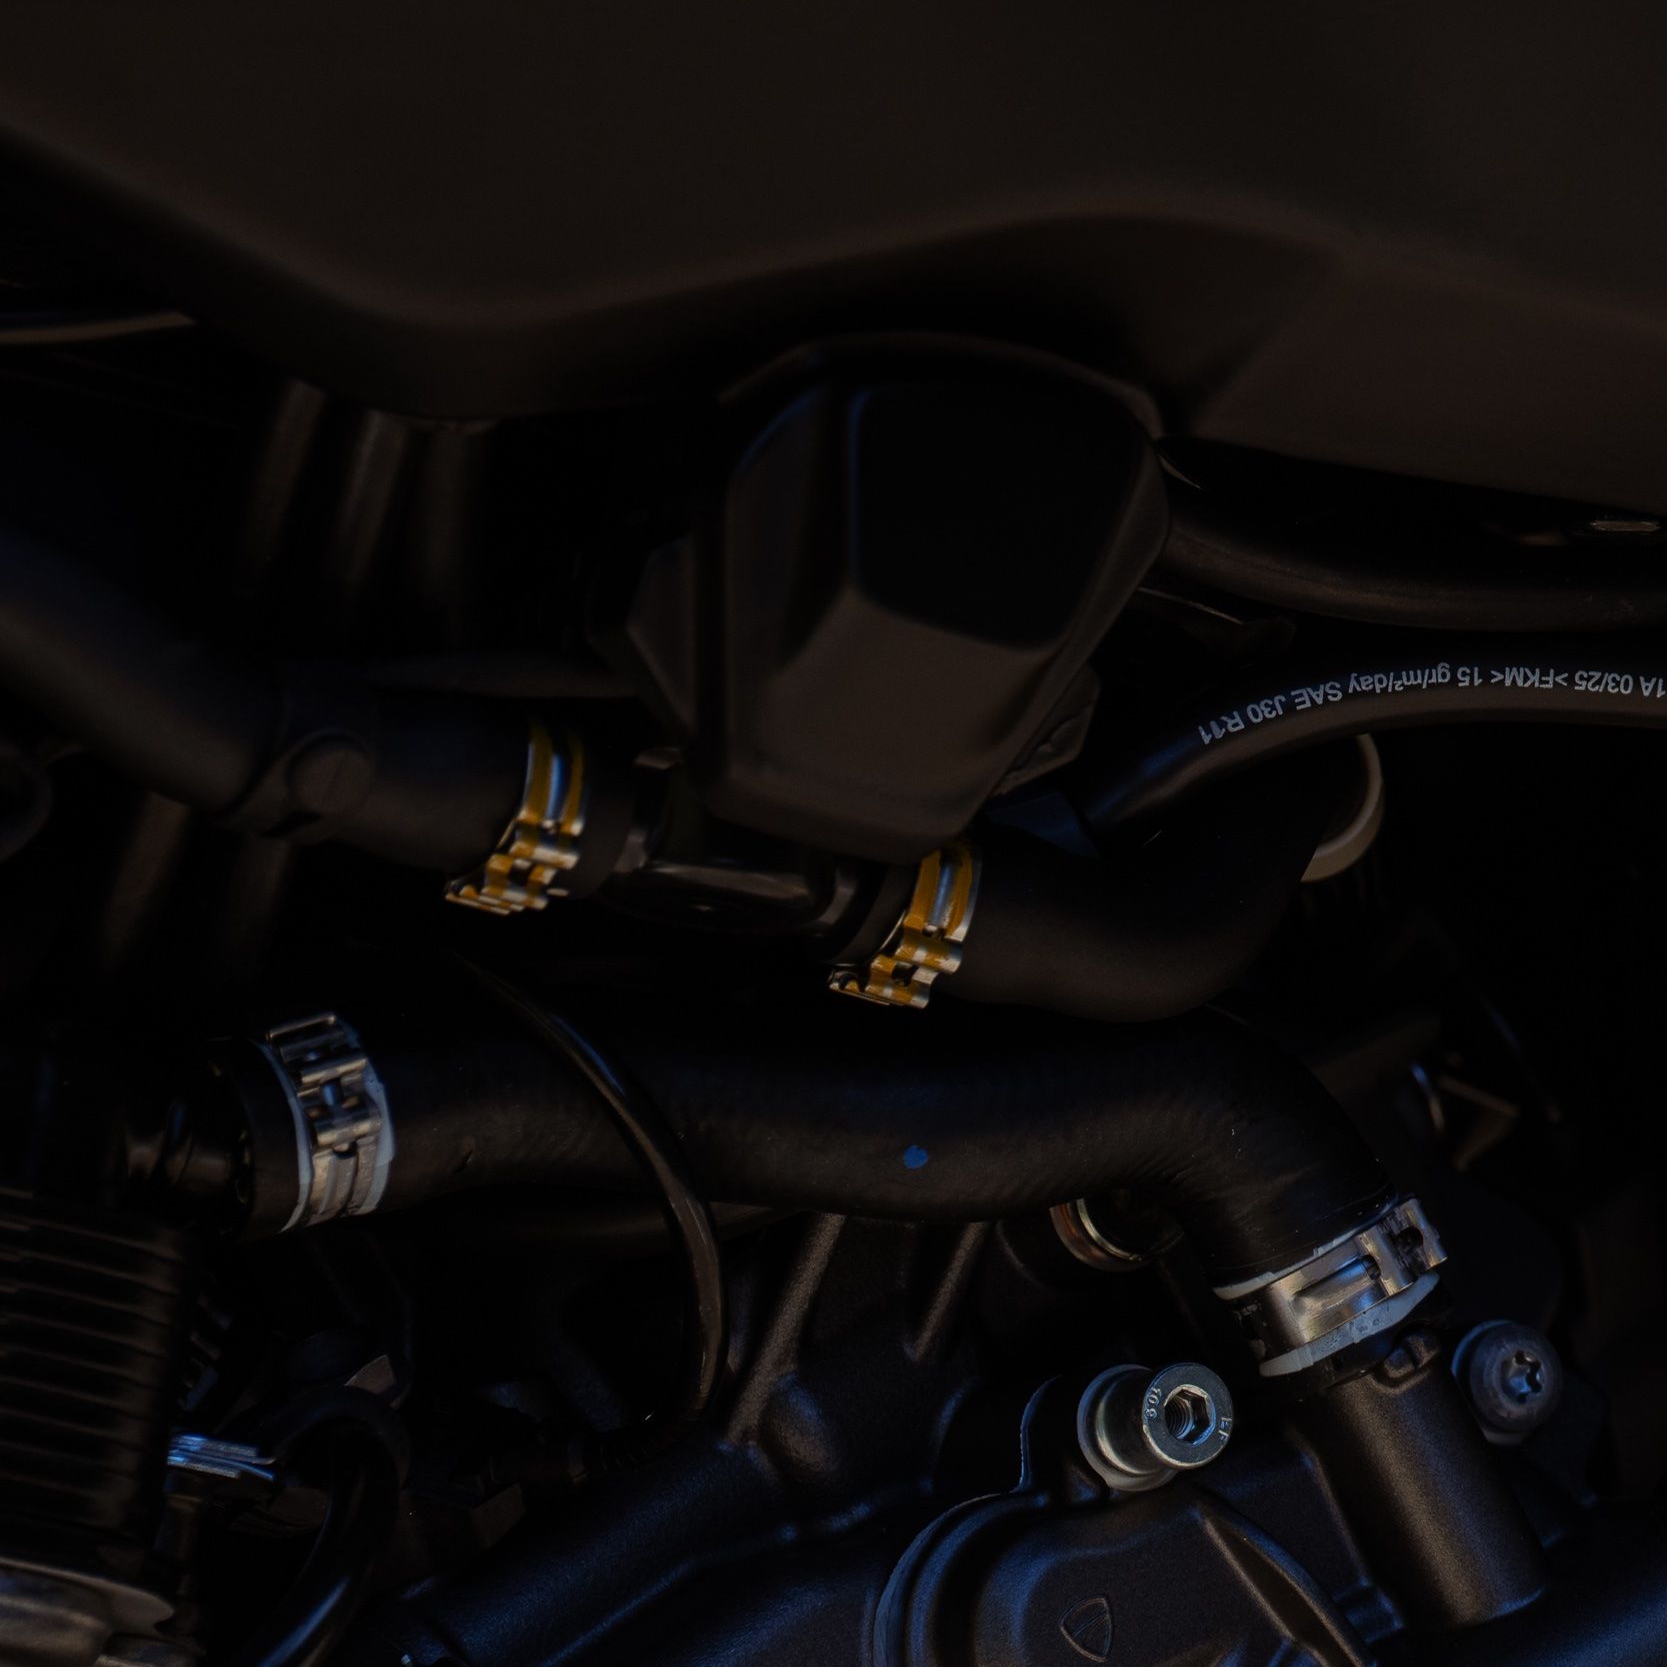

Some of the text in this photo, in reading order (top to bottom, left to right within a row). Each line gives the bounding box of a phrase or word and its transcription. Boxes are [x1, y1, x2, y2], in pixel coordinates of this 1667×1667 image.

[1456, 666, 1483, 687] 15
[1490, 667, 1569, 689] >FKM<
[1574, 670, 1633, 695] 03/25
[1246, 695, 1287, 724] J30
[1290, 681, 1343, 711] SAE
[1199, 711, 1245, 745] R11
